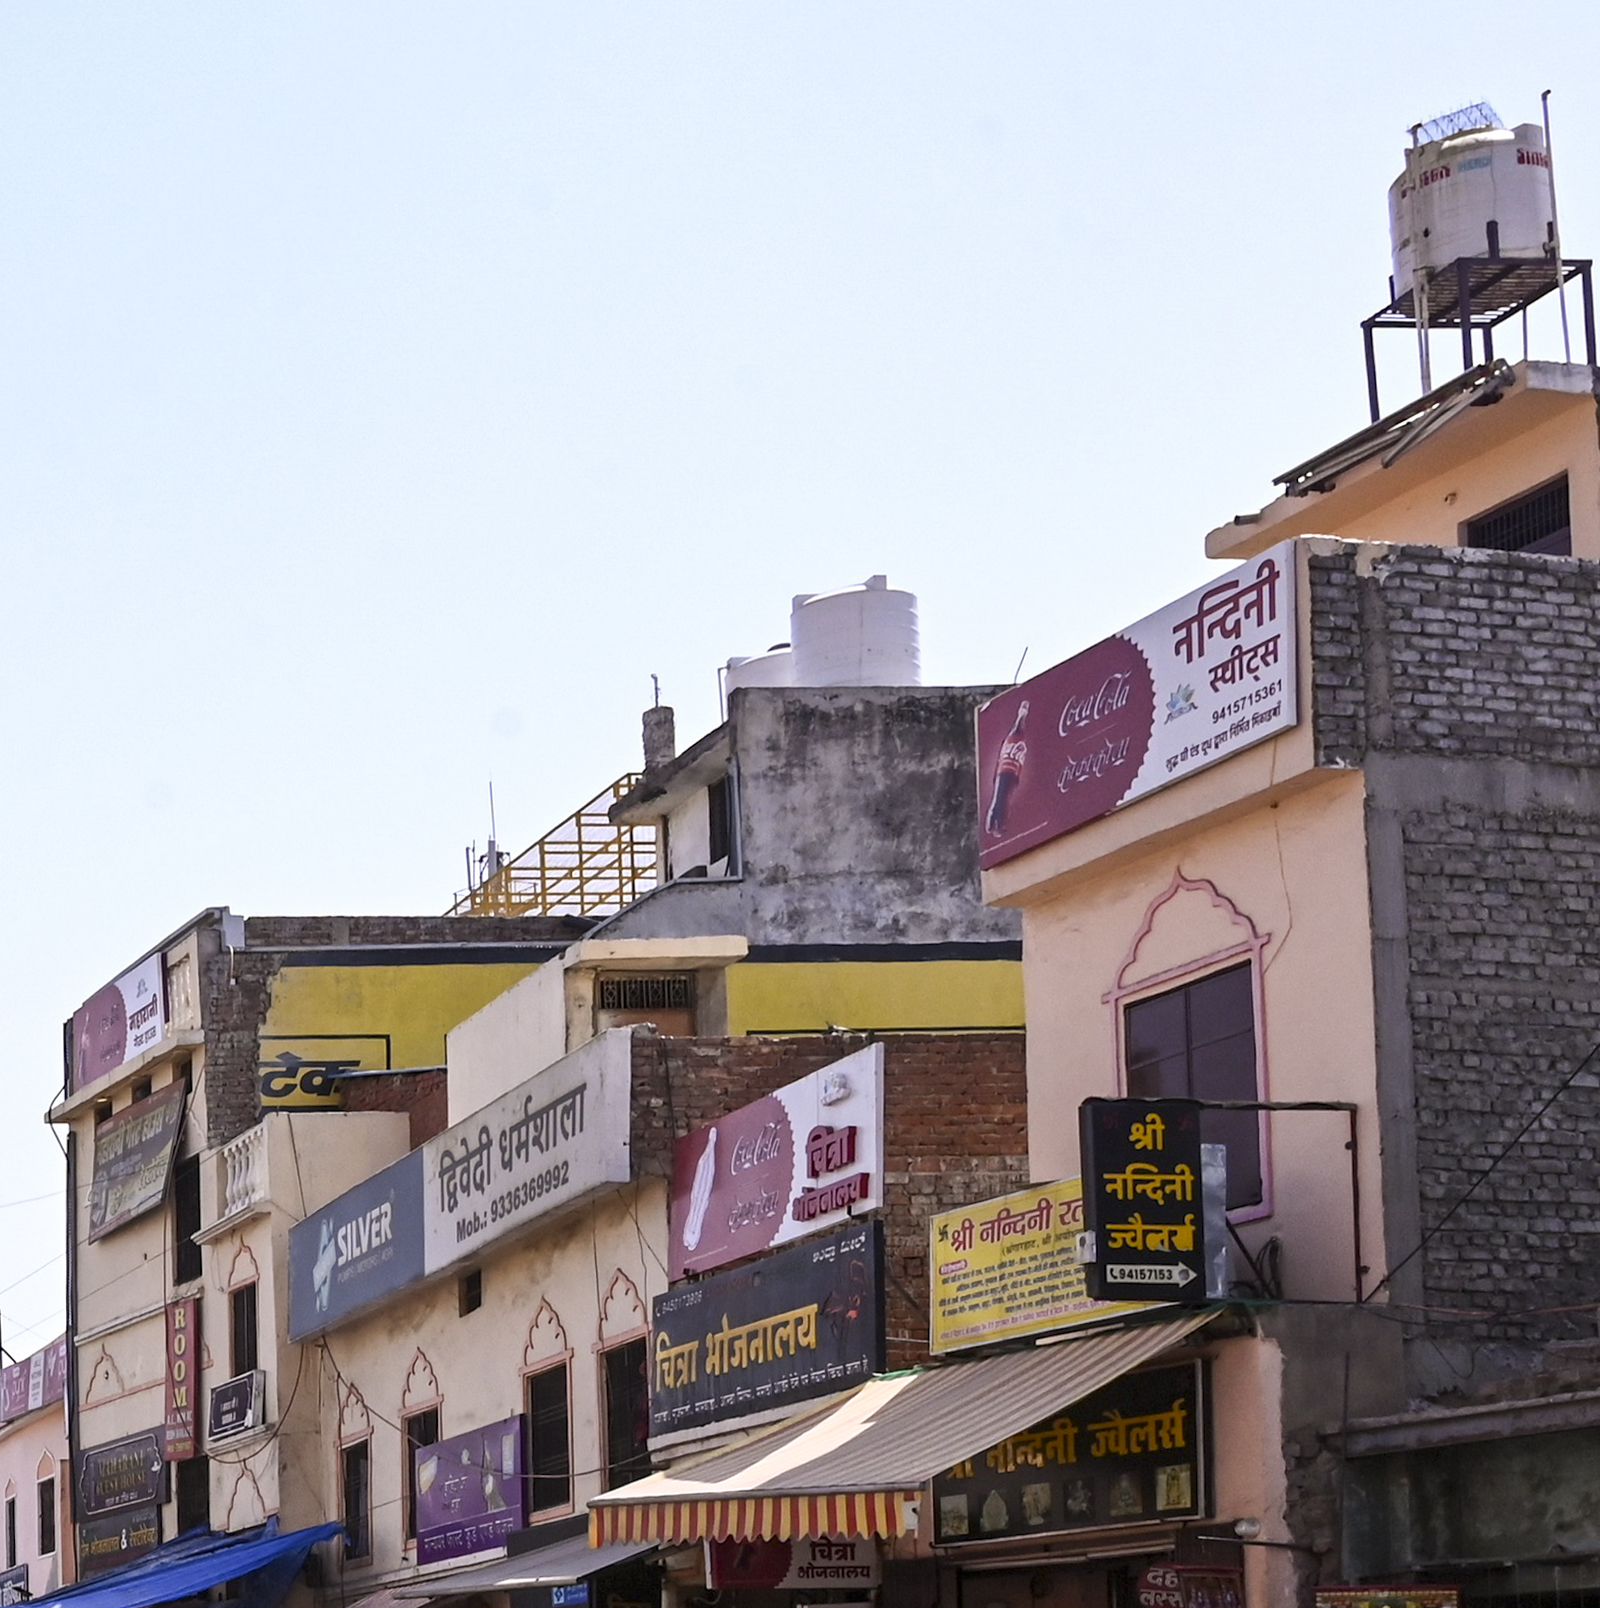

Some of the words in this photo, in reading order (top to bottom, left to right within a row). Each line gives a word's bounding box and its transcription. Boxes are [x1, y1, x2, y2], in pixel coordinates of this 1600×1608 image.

[1172, 558, 1280, 665] नन्दिनी
[1208, 634, 1281, 693] स्वीट्स
[1212, 679, 1282, 724] 9415715361
[438, 1125, 493, 1214] द्विवेदी
[499, 1083, 587, 1172] धर्मशाला
[1129, 1112, 1165, 1150] श्री
[490, 1160, 570, 1224] 9336369992
[1103, 1162, 1195, 1205] नन्दिनी
[337, 1201, 393, 1267] SILVER
[951, 1218, 975, 1253] श्री
[979, 1198, 1054, 1244] नन्दिनी
[1105, 1212, 1196, 1252] ज्वैलर्स
[172, 1308, 188, 1409] ROOM
[655, 1331, 699, 1393] चित्रा
[705, 1313, 818, 1377] भोजनालय
[797, 1562, 871, 1579] भोजनालय
[809, 1536, 856, 1562] चित्रा
[1147, 1567, 1179, 1588] दह
